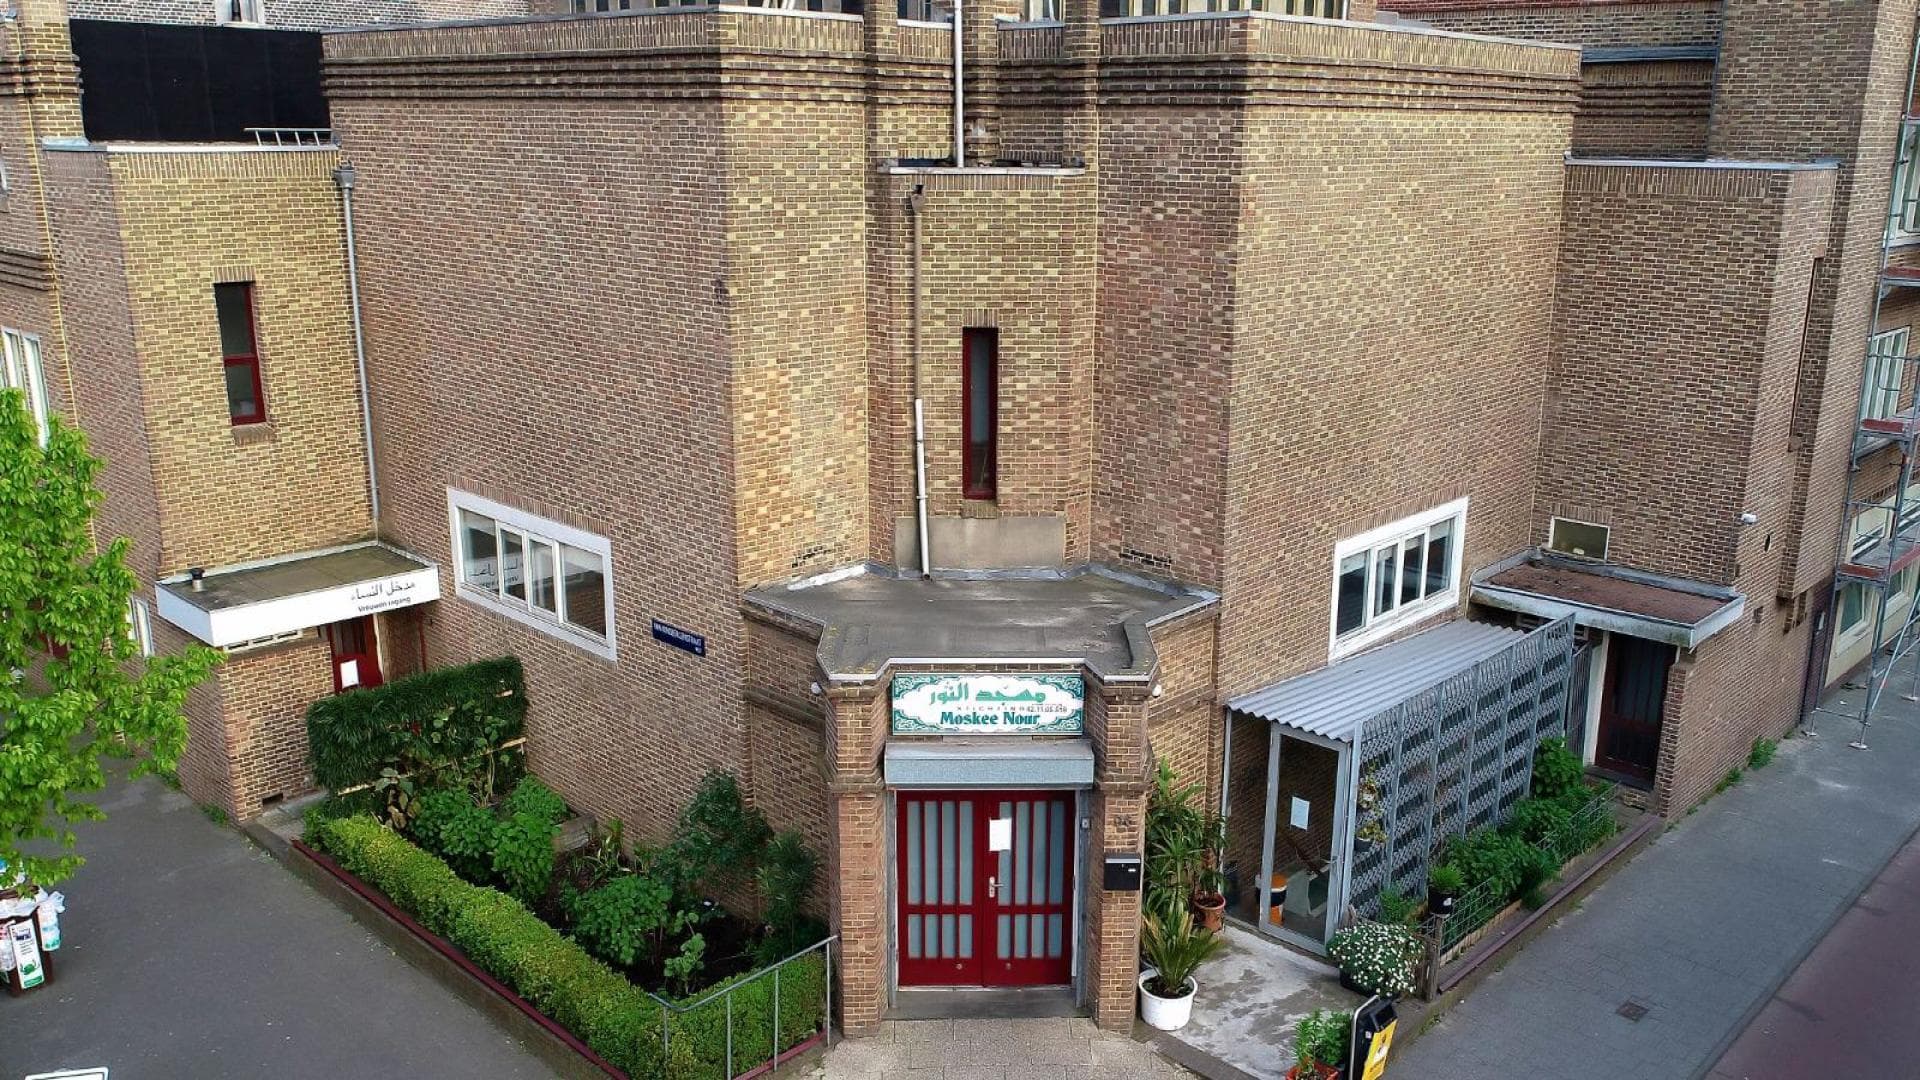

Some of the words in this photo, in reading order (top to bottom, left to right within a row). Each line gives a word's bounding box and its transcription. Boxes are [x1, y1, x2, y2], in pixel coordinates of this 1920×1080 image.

[351, 583, 383, 600] النساء
[387, 581, 415, 596] مدخل
[358, 602, 387, 612] Vrouwen
[975, 684, 1046, 706] مسجد
[940, 712, 998, 725] Moskee
[1003, 712, 1041, 725] Nour
